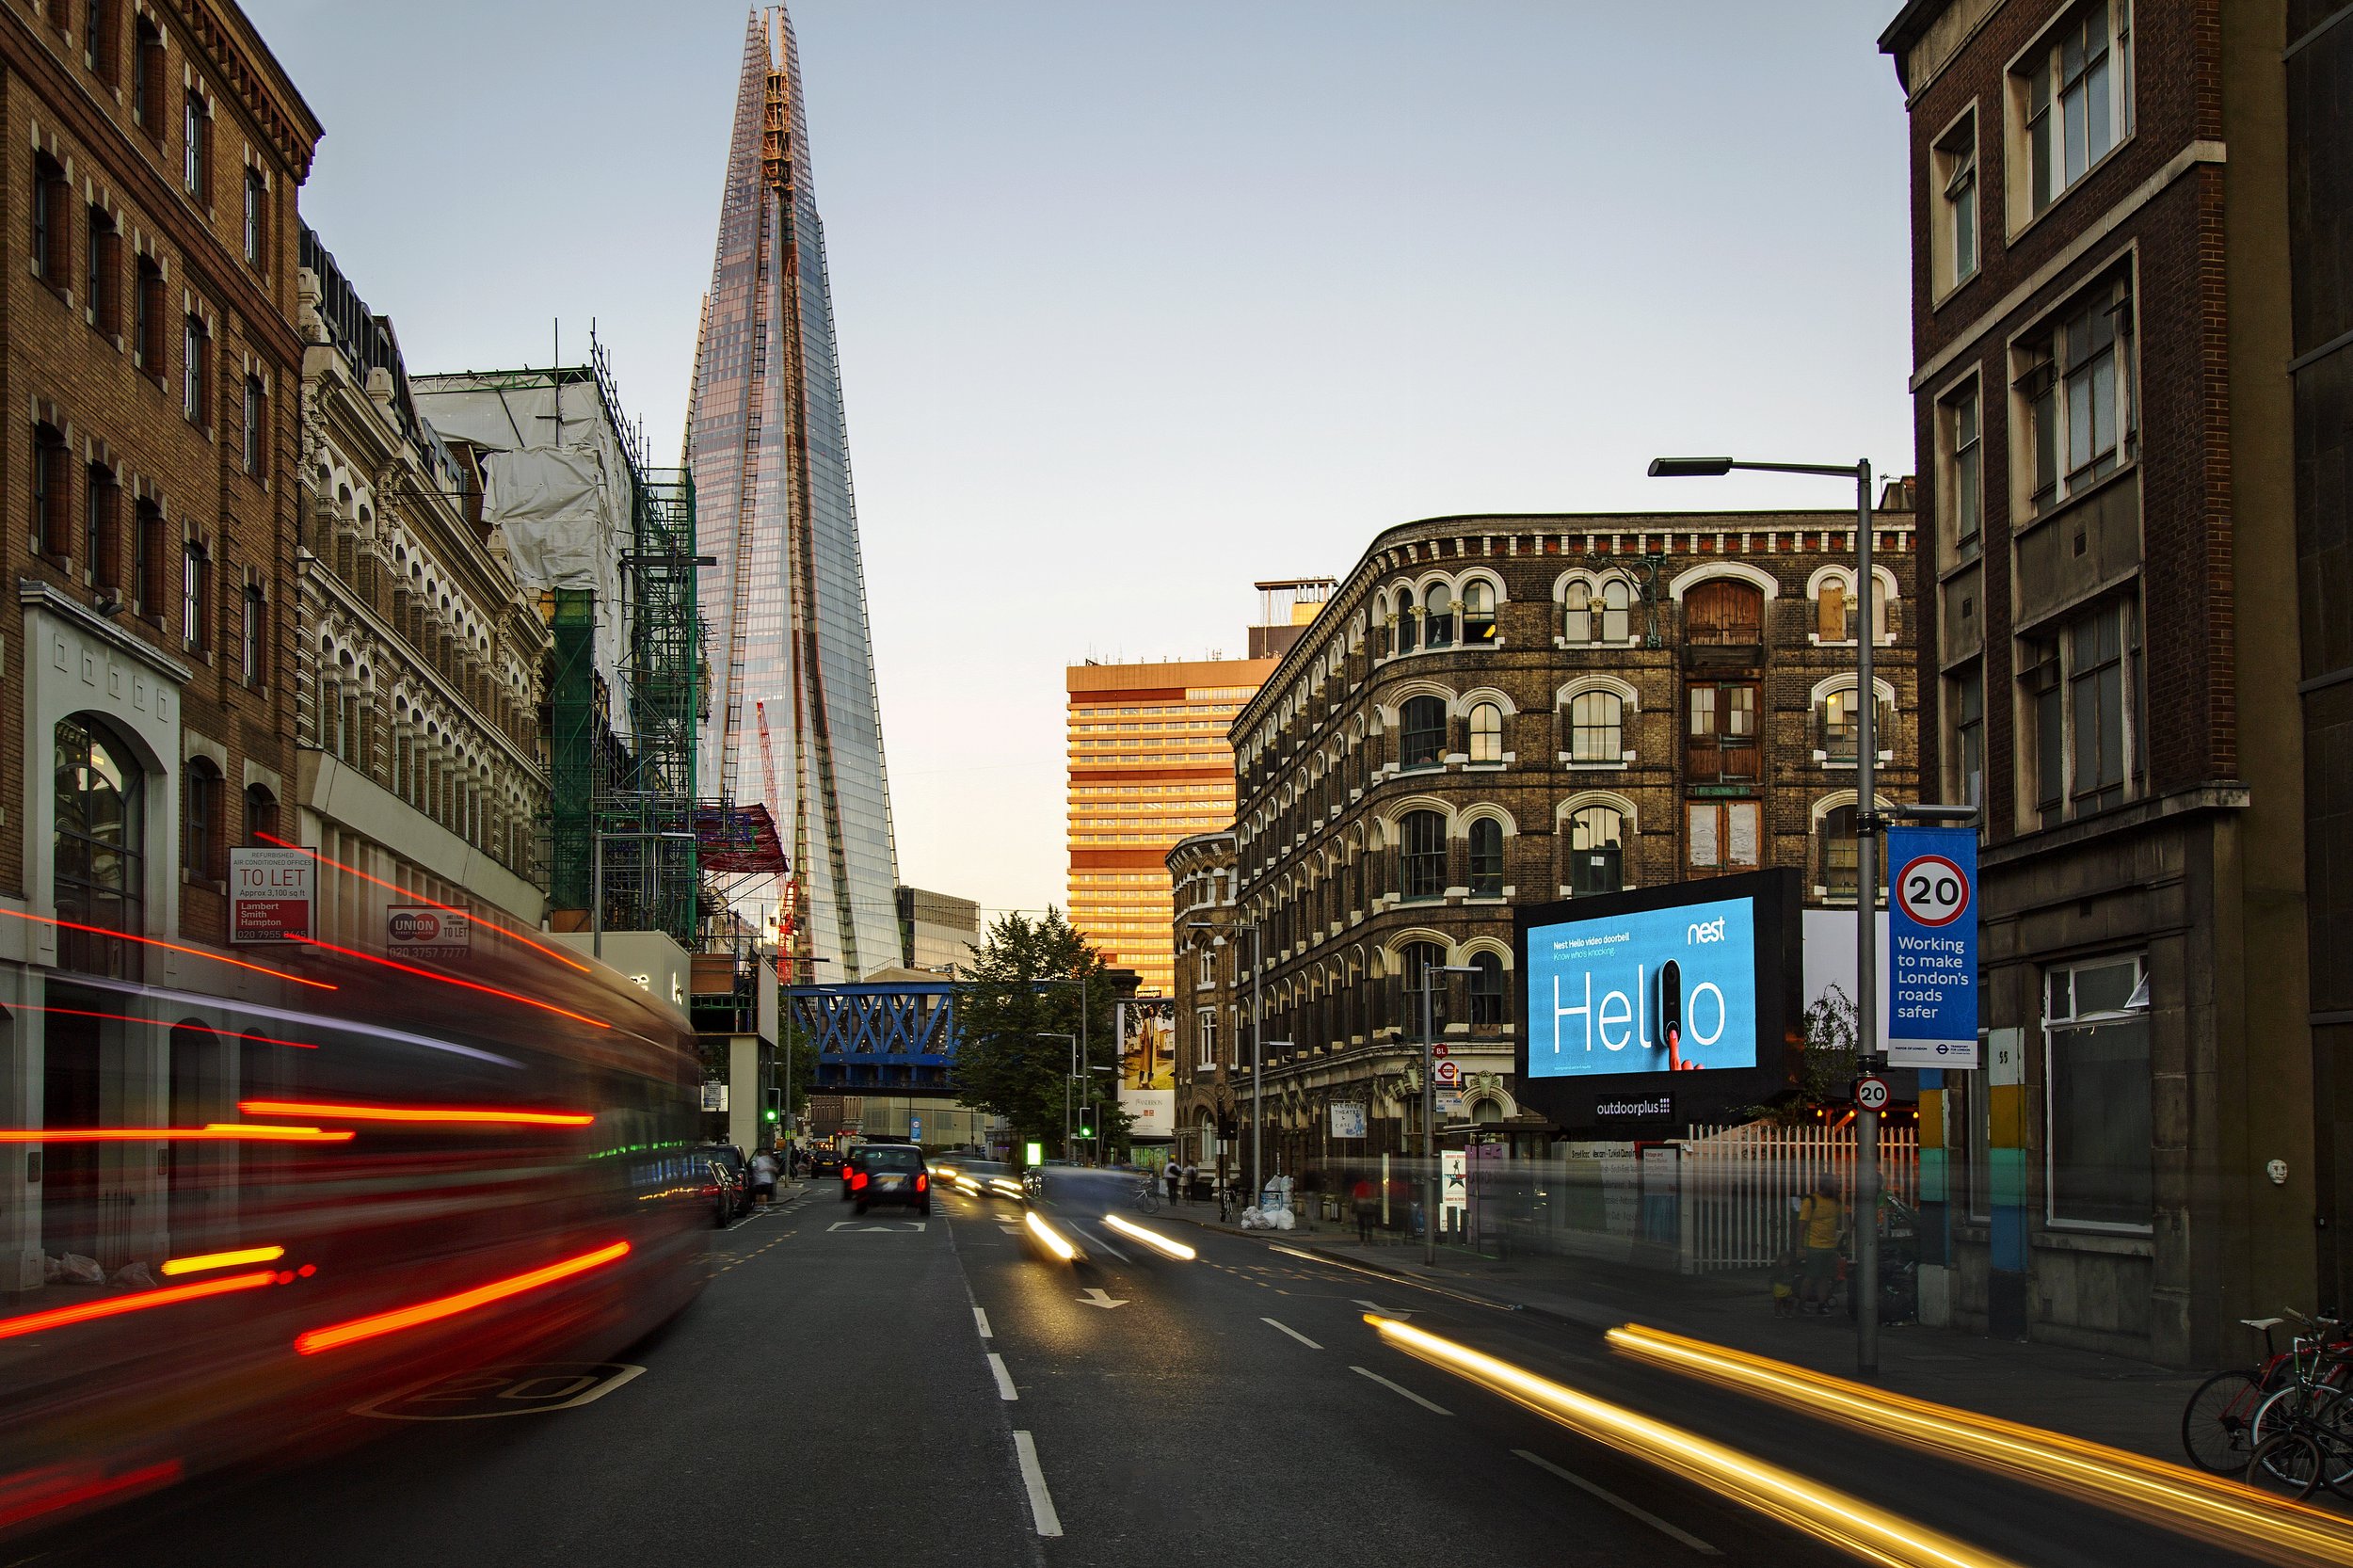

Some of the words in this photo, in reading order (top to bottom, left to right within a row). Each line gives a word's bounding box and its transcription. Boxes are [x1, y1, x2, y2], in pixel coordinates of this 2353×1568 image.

[240, 869, 264, 886] TO
[271, 869, 306, 886] LET
[267, 888, 288, 897] 3,100
[299, 888, 306, 897] ft
[1909, 876, 1960, 906] 20
[241, 910, 267, 919] Smith
[241, 918, 281, 927] Hampton
[395, 920, 434, 931] UNION
[237, 930, 255, 939] 020
[258, 930, 281, 939] 7955
[443, 927, 453, 937] TO
[455, 927, 468, 937] LET
[1688, 916, 1726, 945] nest
[1553, 940, 1569, 951] Nest
[1569, 938, 1585, 949] Hello
[1585, 936, 1603, 946] video
[1603, 932, 1630, 944] doorbell
[1898, 936, 1965, 954] Working
[389, 947, 409, 958] 020
[412, 947, 439, 958] 3757
[441, 947, 468, 958] 7777
[1554, 952, 1571, 961] Know
[1571, 949, 1588, 959] who's
[1898, 954, 1915, 968] to
[1920, 954, 1963, 968] make
[1898, 970, 1969, 985] London's
[1898, 988, 1943, 1002] roads
[1898, 1004, 1939, 1018] safer
[1861, 1086, 1885, 1101] 20
[1597, 1099, 1659, 1116] outdoorplus
